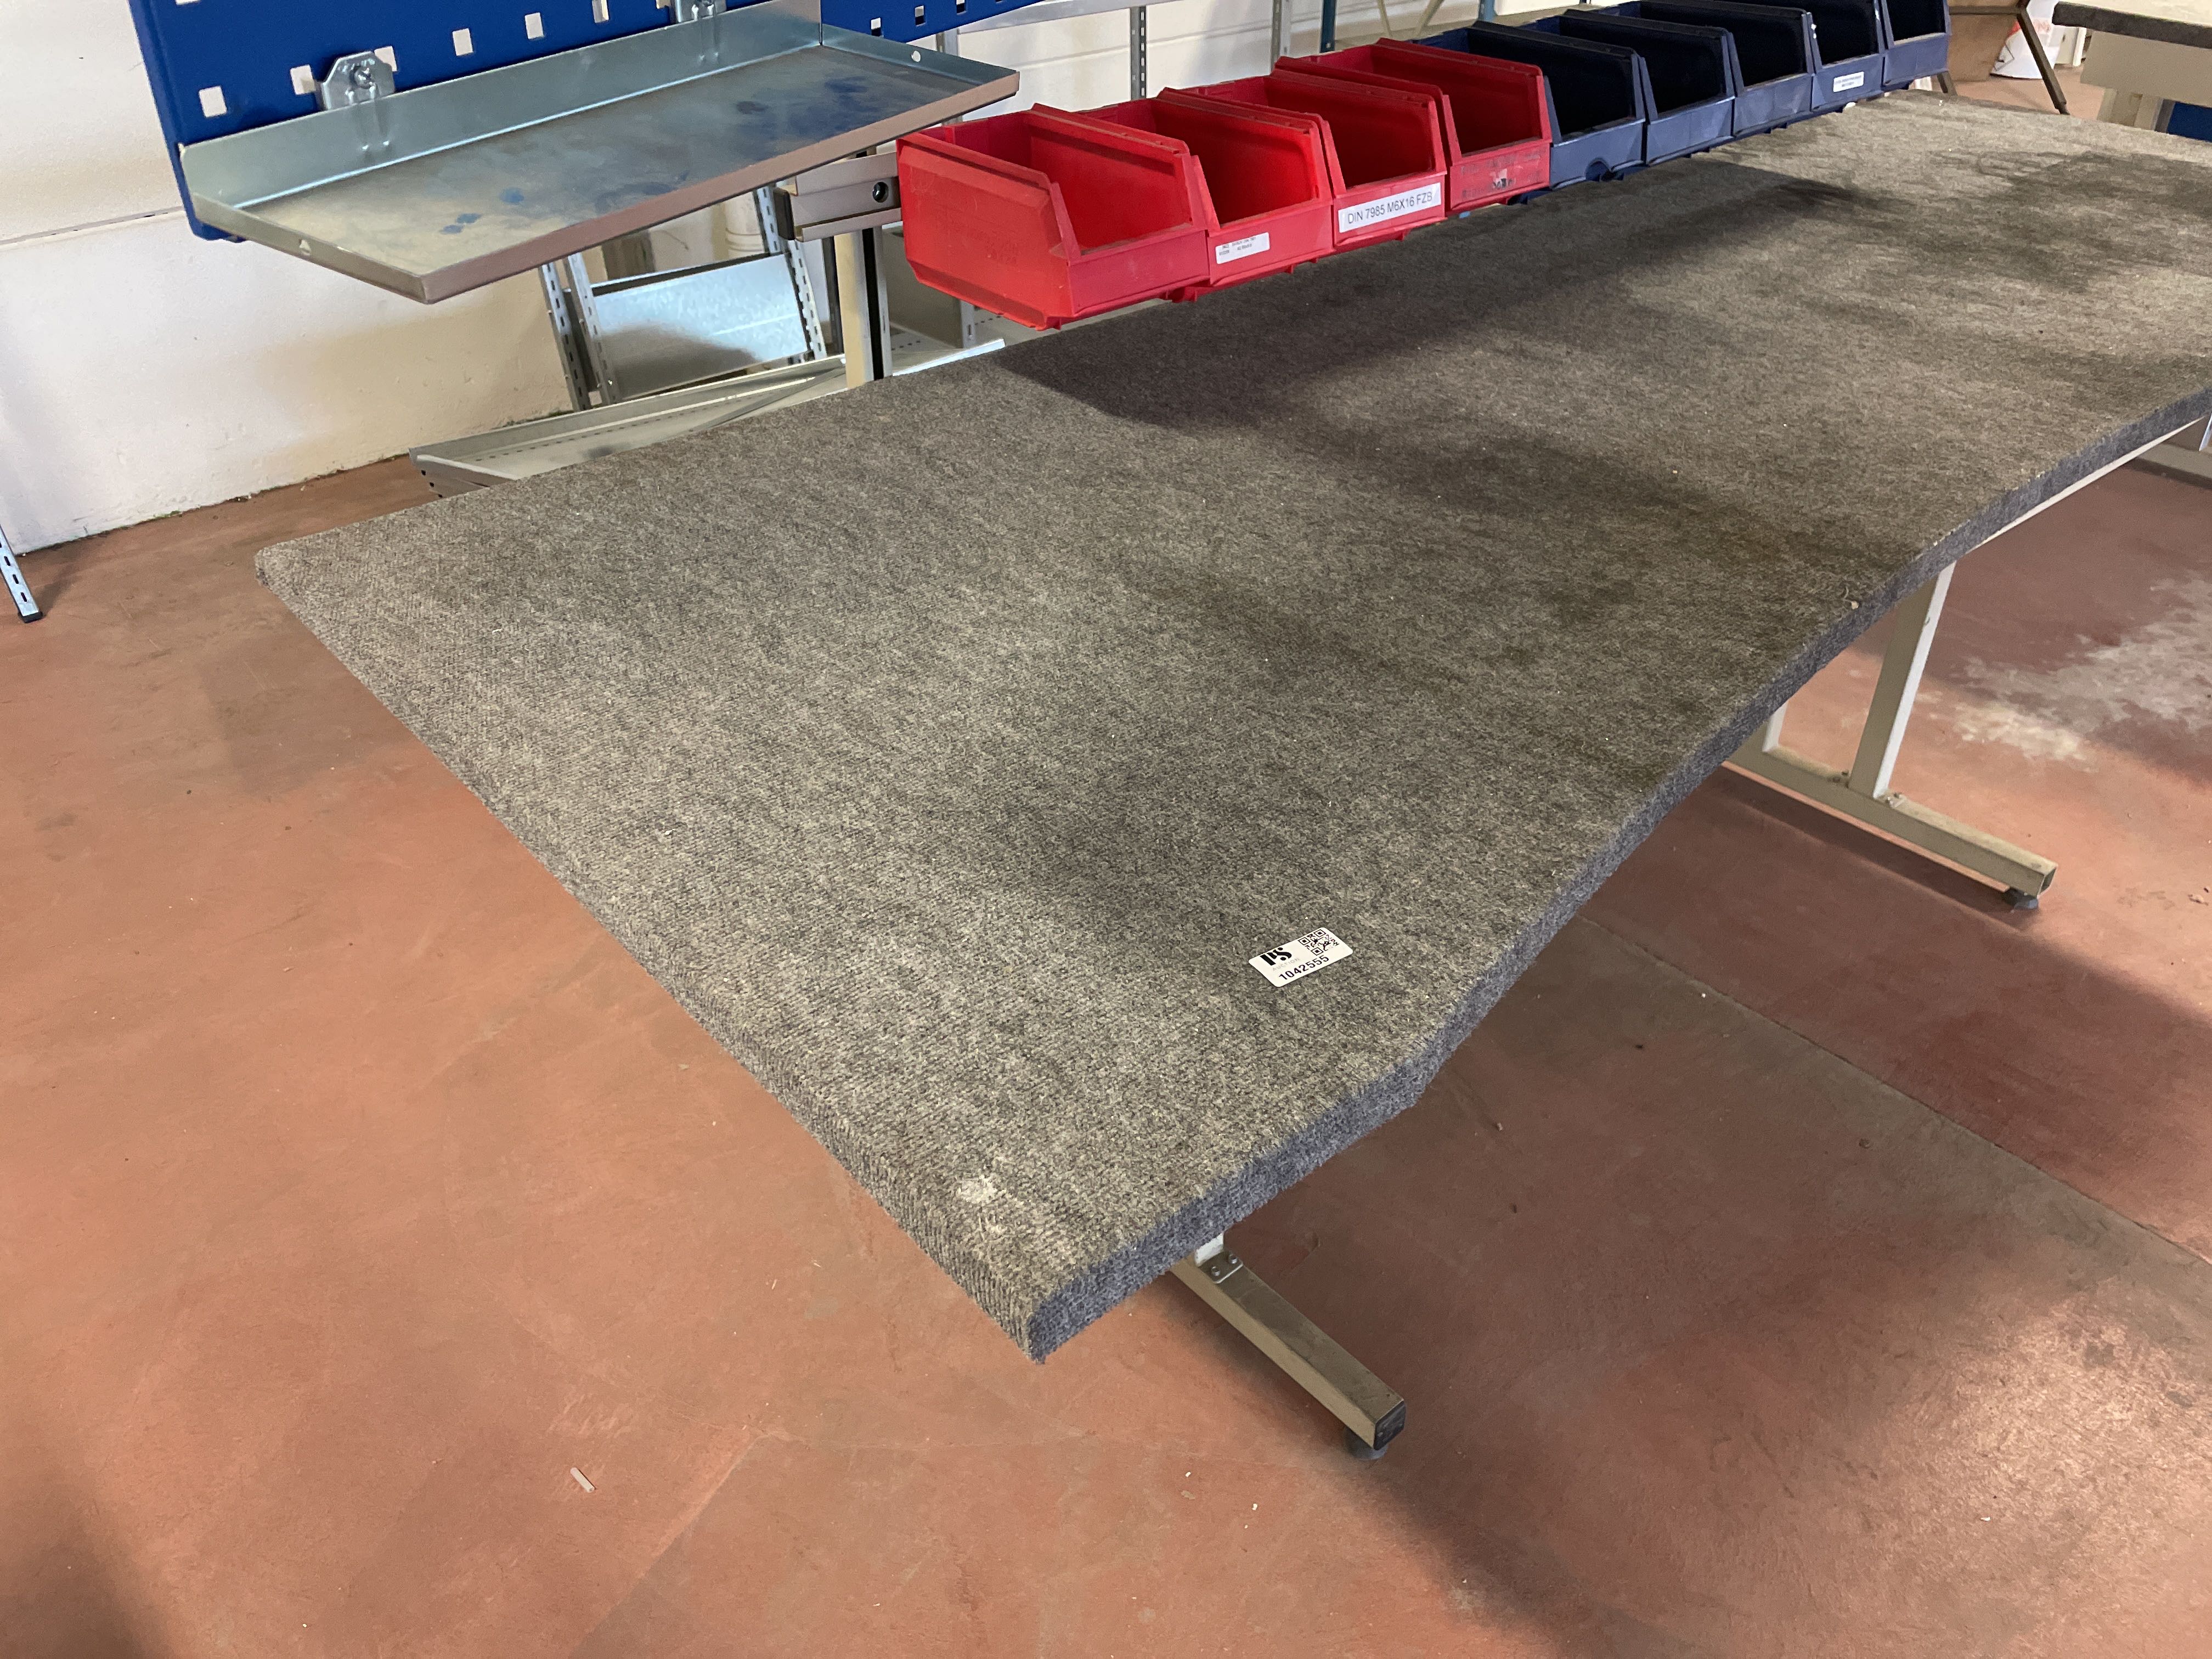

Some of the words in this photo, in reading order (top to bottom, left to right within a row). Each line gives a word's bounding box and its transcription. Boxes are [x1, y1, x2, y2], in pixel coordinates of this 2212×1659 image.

[1347, 210, 1363, 224] DIN
[1365, 204, 1385, 219] 7985
[1387, 196, 1414, 213] M6X16
[1417, 191, 1432, 205] FZB
[1272, 957, 1300, 972] AUCTION
[1279, 955, 1329, 980] 1042555
